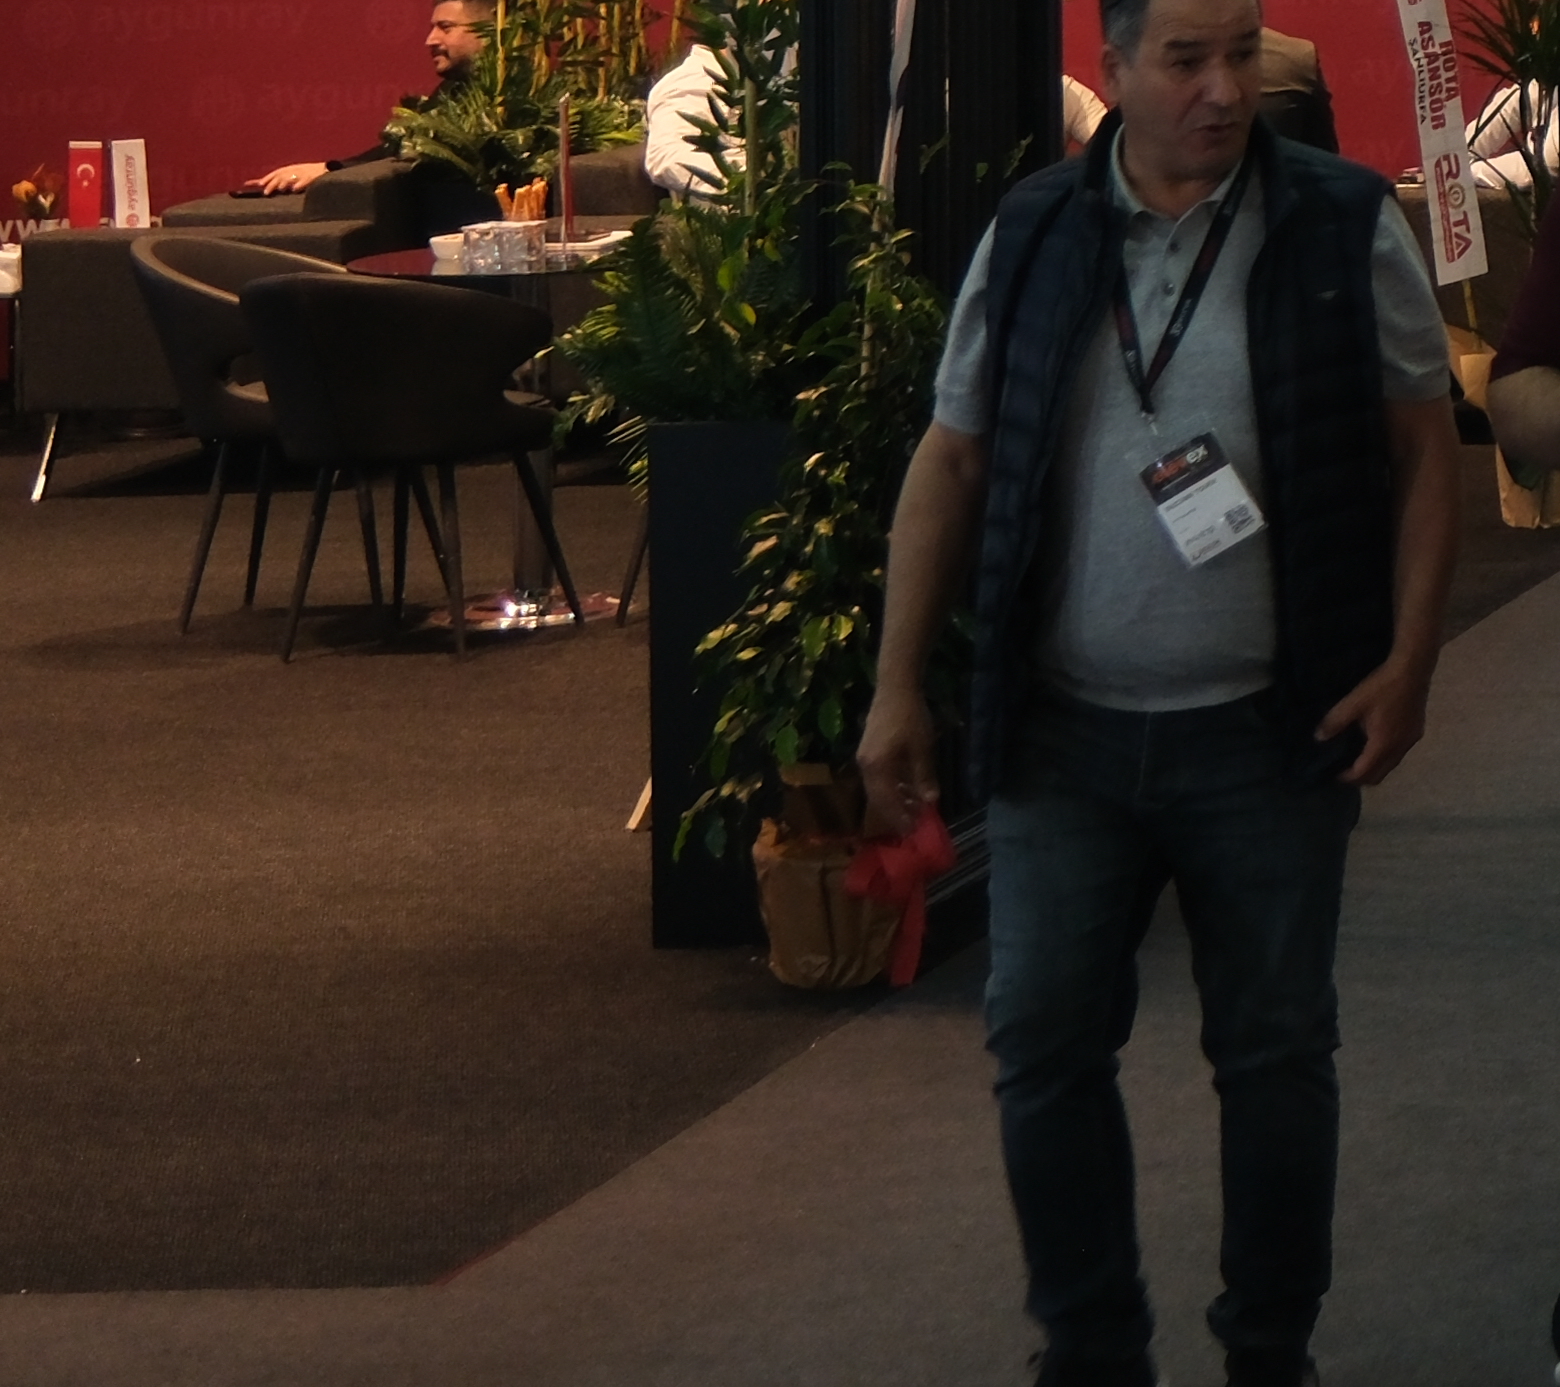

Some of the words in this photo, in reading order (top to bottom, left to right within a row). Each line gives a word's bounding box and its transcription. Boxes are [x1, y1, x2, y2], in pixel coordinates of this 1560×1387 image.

[1417, 20, 1448, 131] ASANSÖR
[1438, 39, 1460, 103] ROTA
[1442, 152, 1474, 261] ROTA
